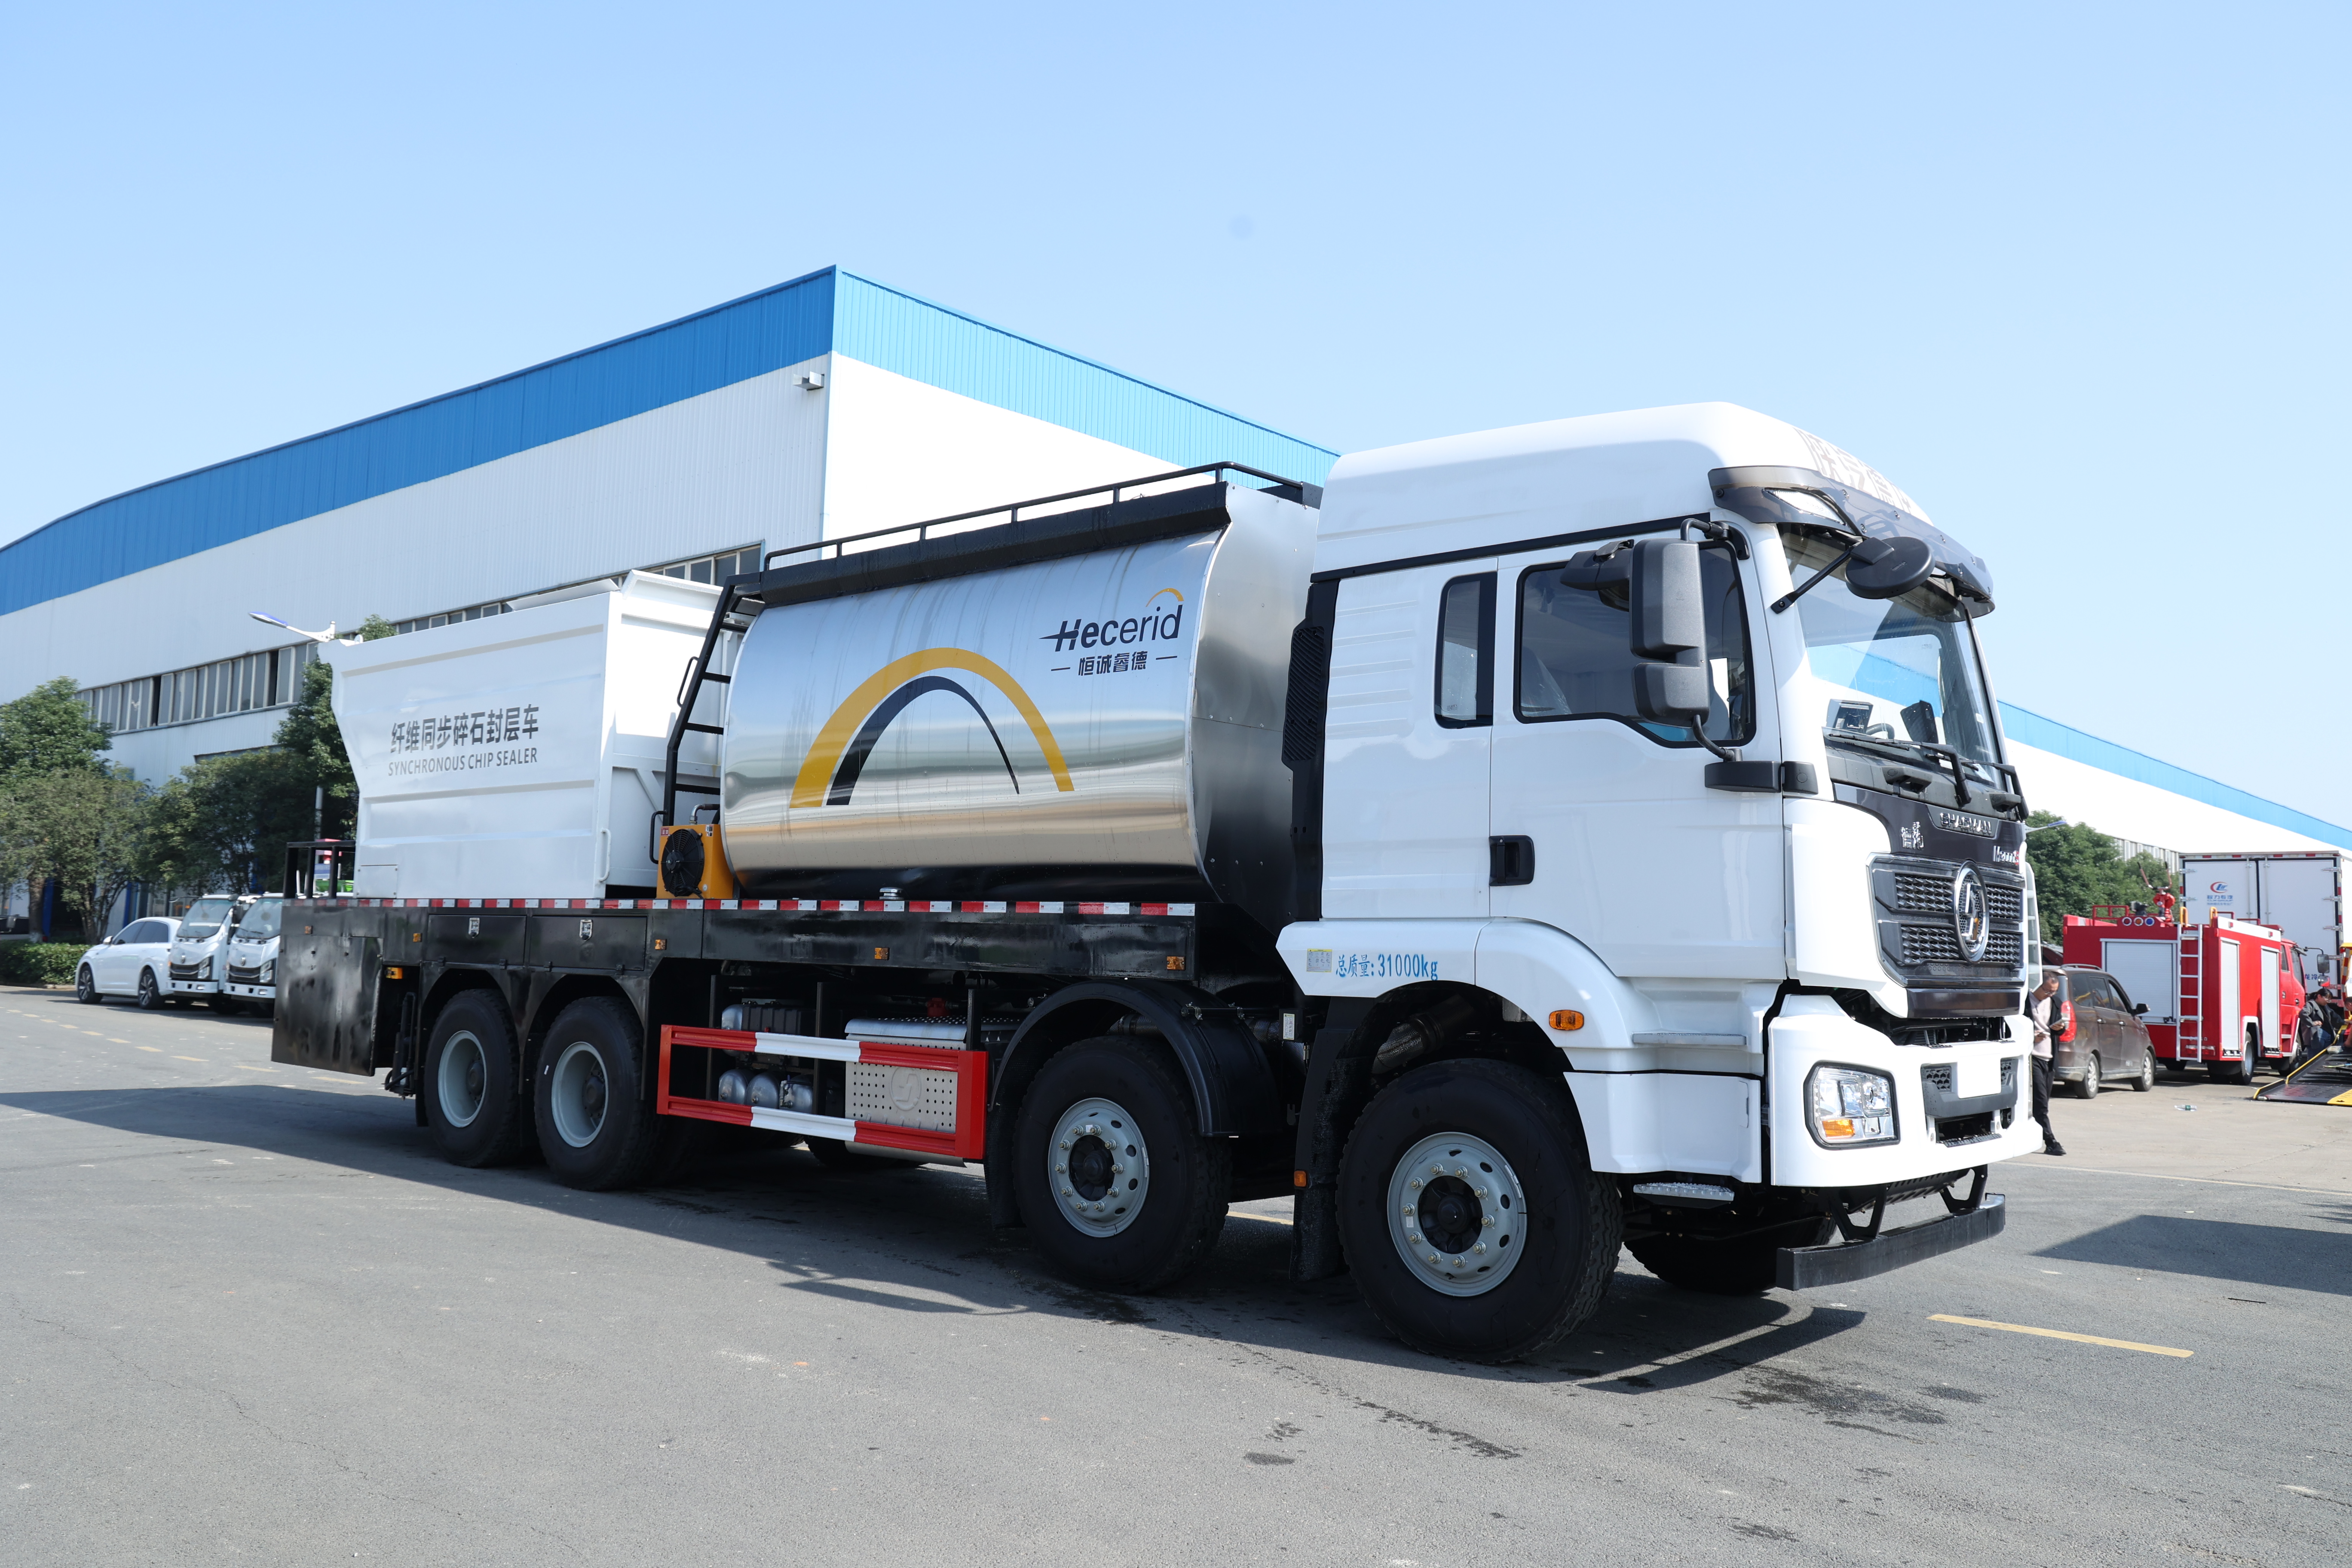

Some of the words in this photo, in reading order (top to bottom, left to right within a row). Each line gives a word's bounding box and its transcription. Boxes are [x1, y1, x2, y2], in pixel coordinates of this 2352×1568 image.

[1039, 604, 1183, 652] Hecerid
[1078, 651, 1148, 676] 恒诚睿德
[390, 704, 539, 754] 纤维同步碎石封层车
[388, 755, 466, 776] SYNCHRONOUS
[468, 752, 494, 769] CHIP
[496, 747, 538, 766] SEALER
[1940, 812, 1992, 834] SHACMAN
